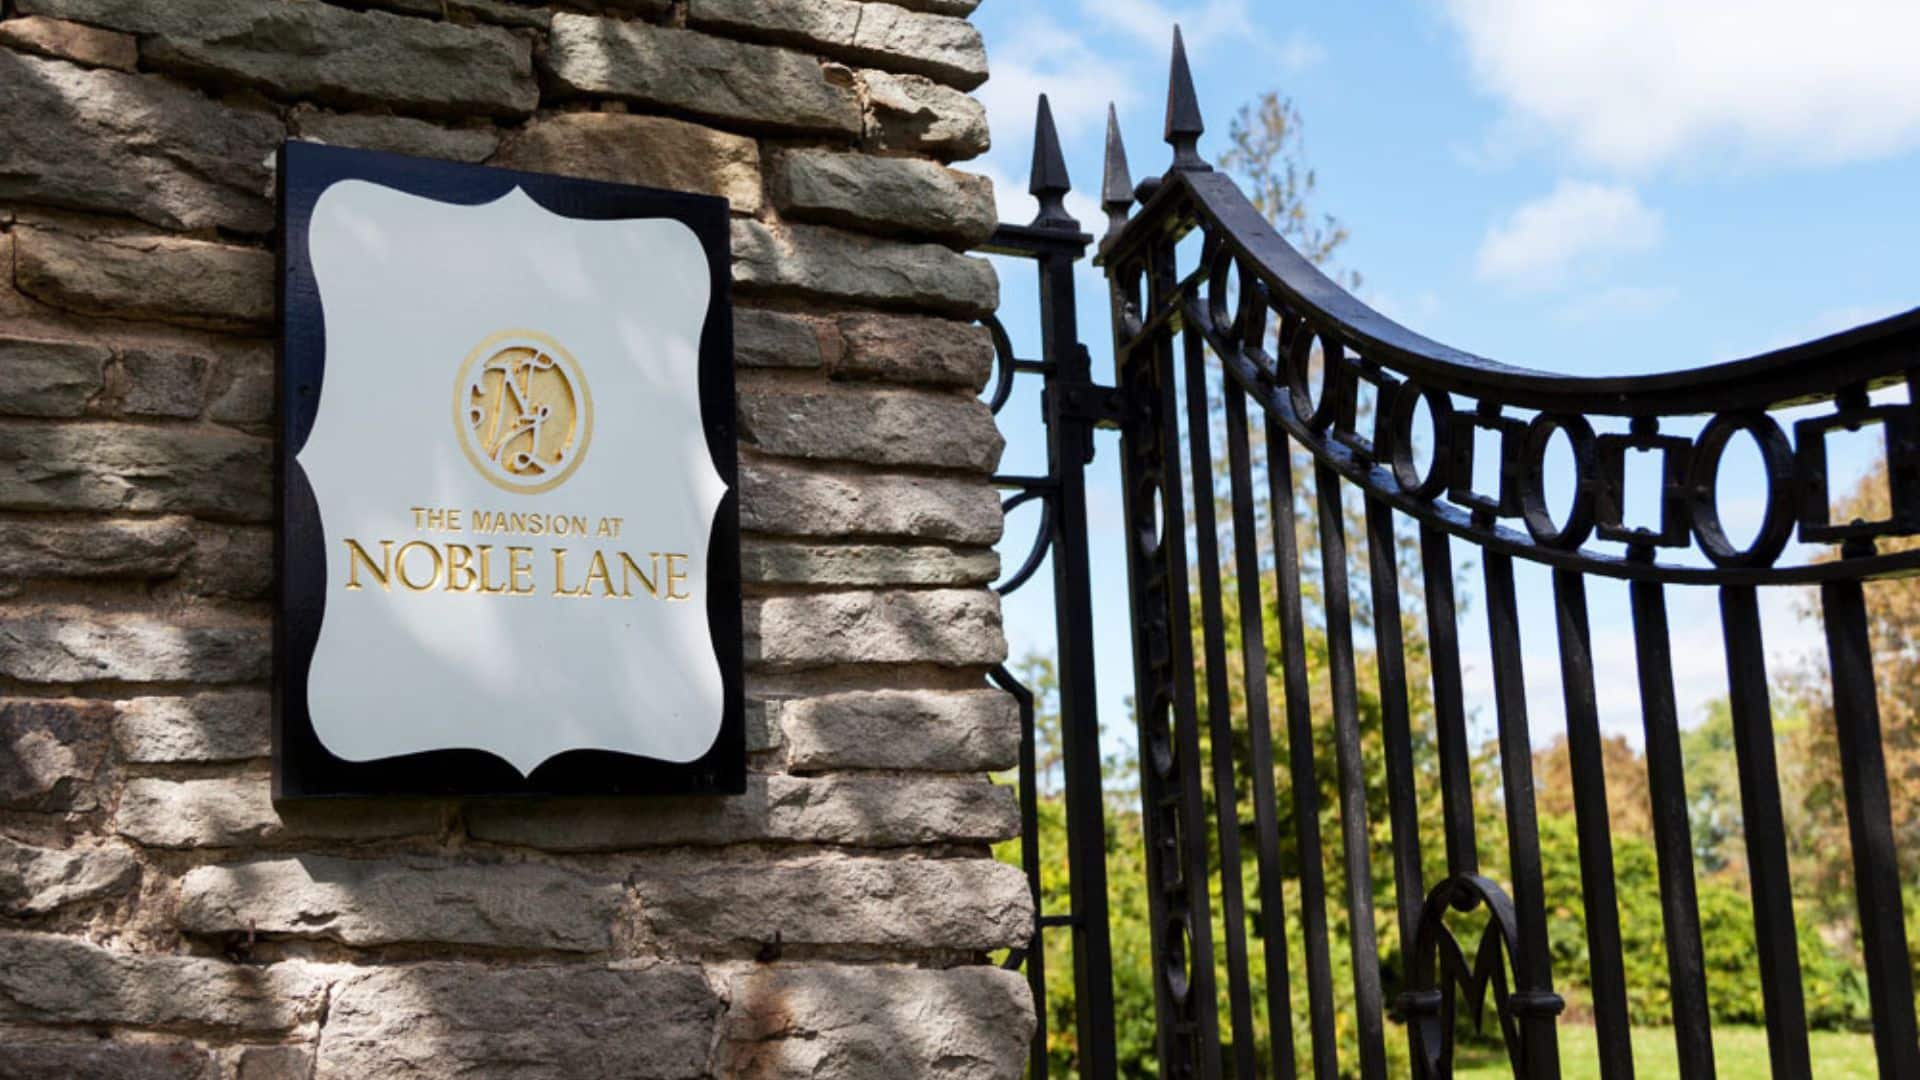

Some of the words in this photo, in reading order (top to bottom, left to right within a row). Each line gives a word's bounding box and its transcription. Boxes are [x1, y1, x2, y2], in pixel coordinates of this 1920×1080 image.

[410, 507, 462, 531] THE
[472, 510, 588, 537] MANSION
[597, 517, 624, 538] AT
[343, 538, 537, 595] NOBLE
[551, 548, 691, 600] LANE
